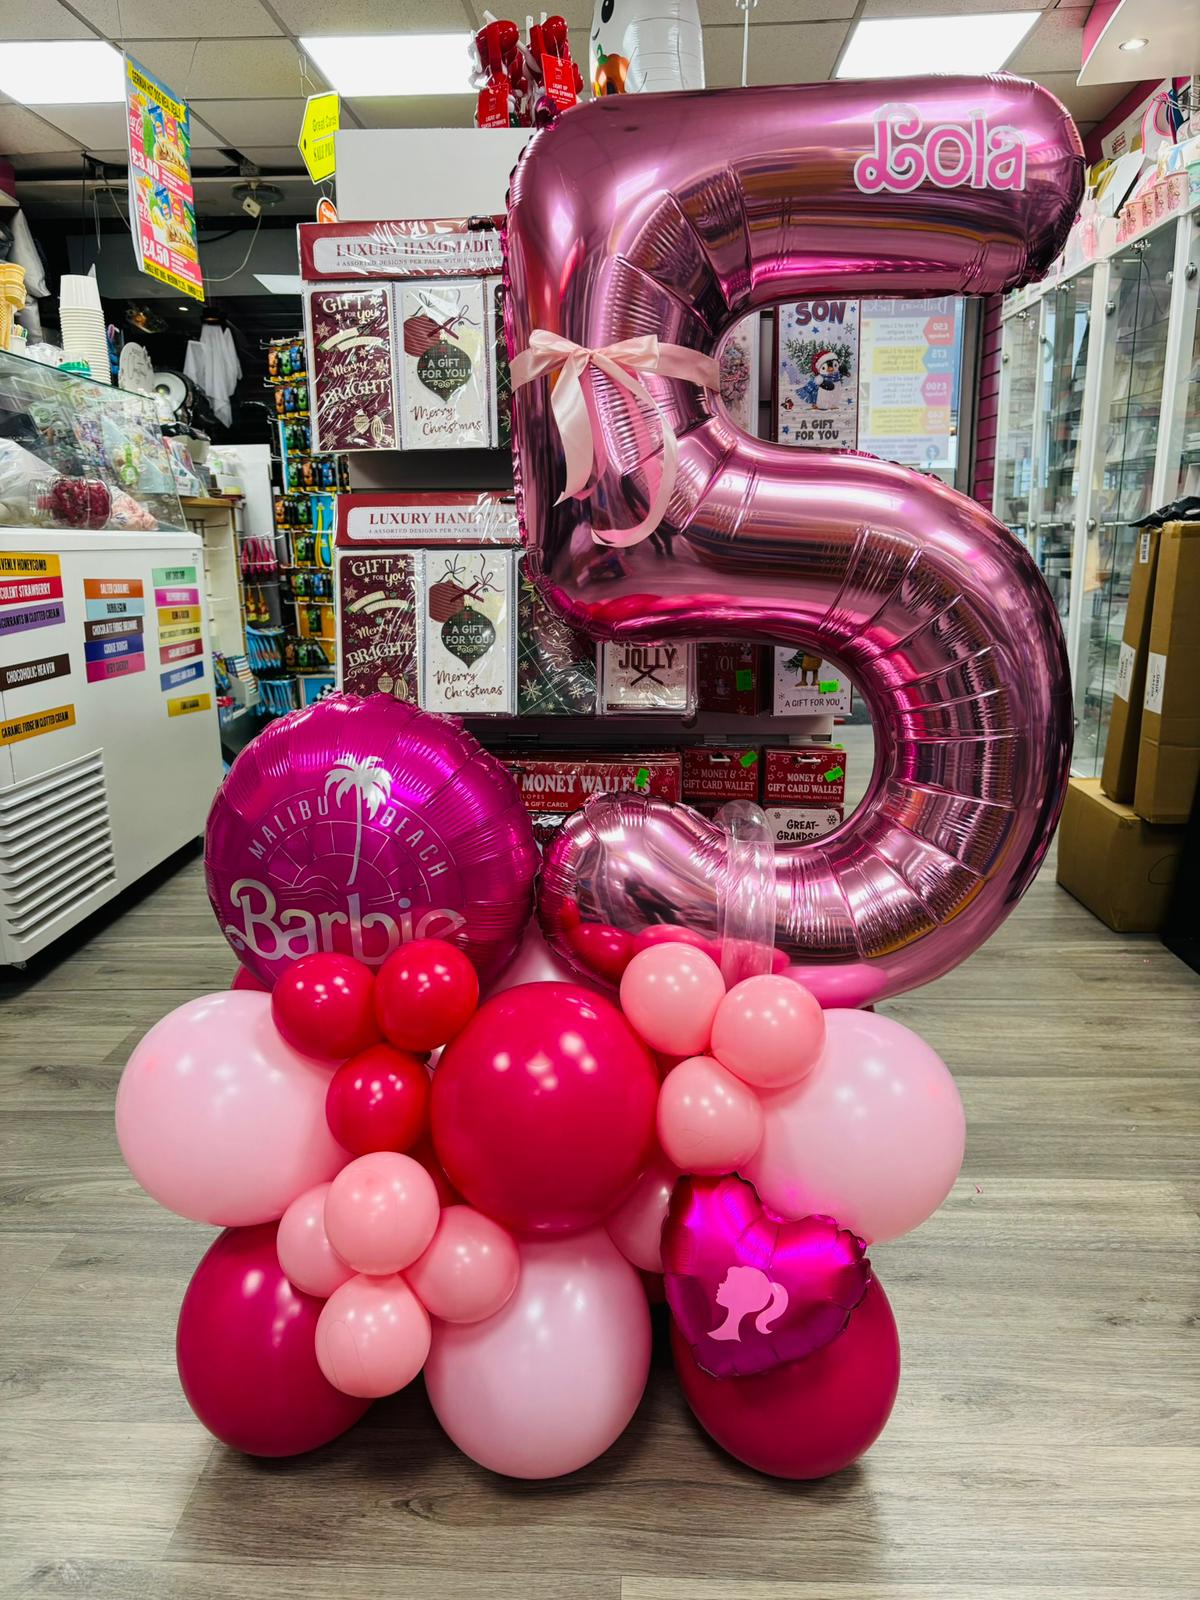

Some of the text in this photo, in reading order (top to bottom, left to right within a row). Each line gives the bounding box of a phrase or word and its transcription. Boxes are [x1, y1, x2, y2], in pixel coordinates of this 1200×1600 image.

[853, 102, 1026, 194] Lola
[336, 242, 400, 257] LUXURY
[404, 239, 494, 255] HANDMADE
[322, 295, 366, 313] GIFT
[795, 300, 847, 327] SON
[331, 362, 368, 378] Merry
[427, 358, 460, 368] A GIFT
[422, 368, 466, 379] FOR YOU
[321, 378, 389, 404] BRIGHT
[410, 405, 455, 421] Merry
[422, 420, 482, 436] Christmas
[800, 418, 835, 430] A GIFT
[795, 430, 840, 441] FOR YOU
[369, 511, 518, 525] LUXURY HANDMAD
[351, 558, 394, 577] GIFT
[372, 571, 406, 588] FOR you
[355, 624, 392, 640] Merry
[451, 624, 484, 634] A GIFT
[445, 635, 489, 644] FOR YOU
[346, 640, 413, 667] BRIGHT
[618, 647, 678, 670] JOLLY
[6, 661, 56, 684] CHOCOHOLIC HEAVEN
[432, 670, 478, 685] Merry
[444, 684, 503, 700] Christmas
[785, 698, 840, 708] A GIFT FOR YOU
[1, 723, 23, 738] CARAMEL
[701, 768, 737, 779] MONEY &
[786, 773, 824, 783] MONEY &
[521, 774, 578, 793] MONEY
[682, 779, 755, 791] GIFT CARD WALLET
[767, 783, 843, 795] GIFT CARD WALLET
[530, 800, 546, 808] GIFT
[546, 801, 569, 809] CARDS
[786, 818, 820, 830] GREAT-
[247, 795, 449, 878] MALIBU BEACH
[226, 878, 467, 965] Barbie
